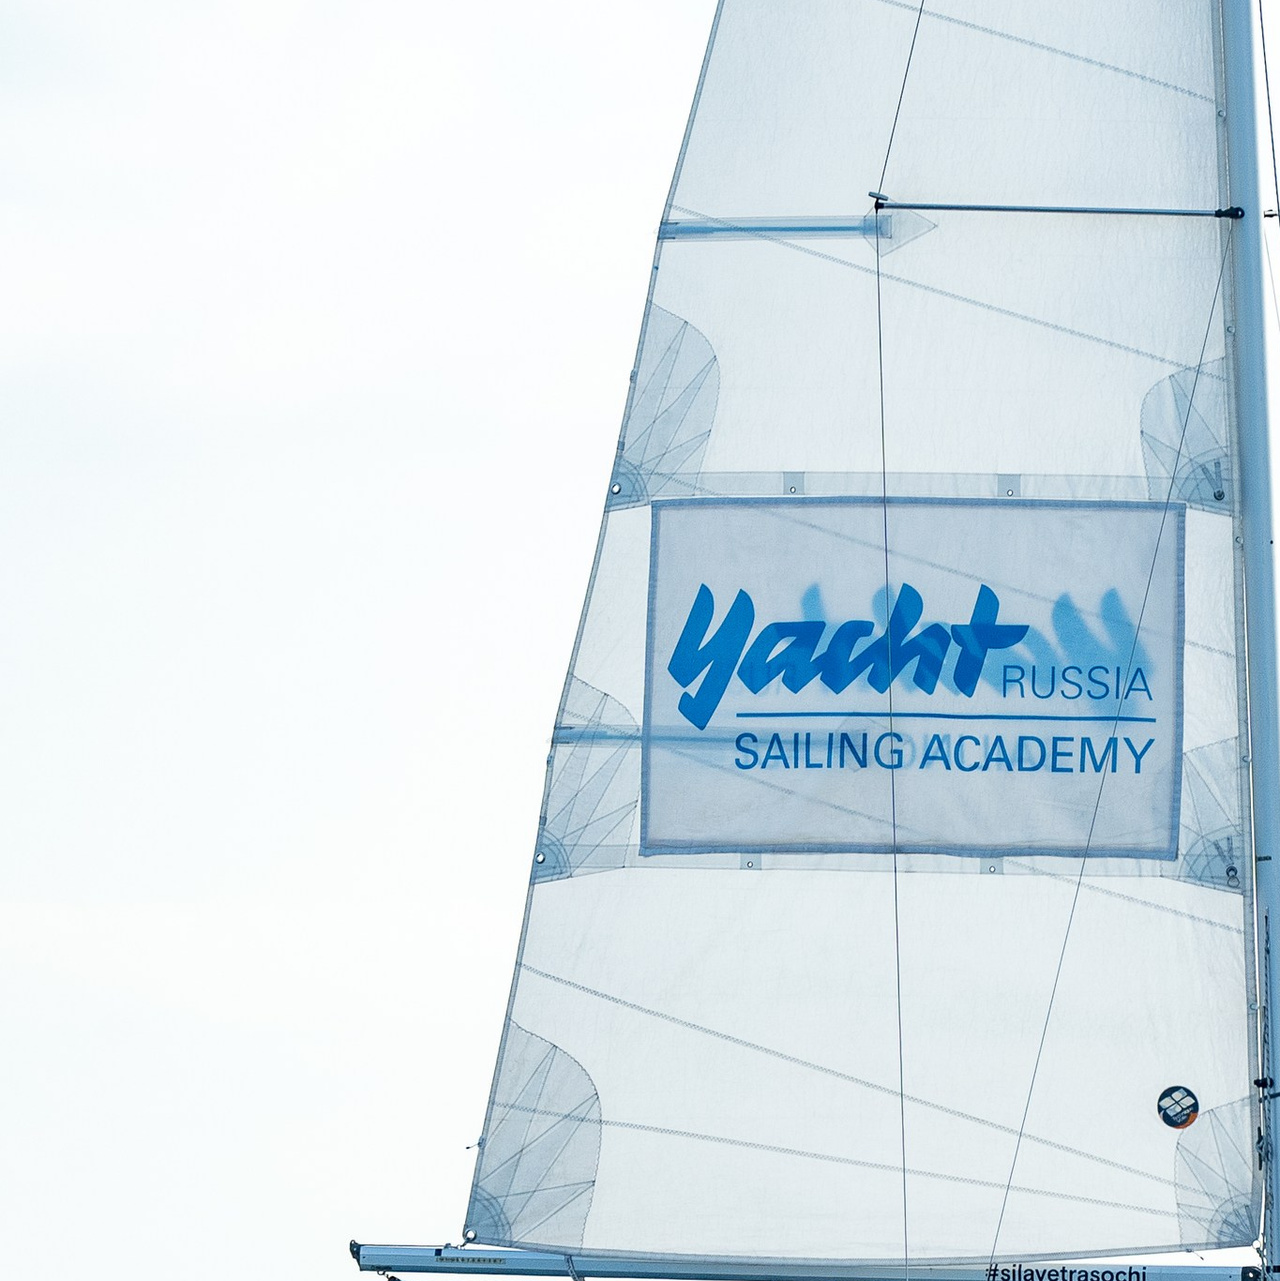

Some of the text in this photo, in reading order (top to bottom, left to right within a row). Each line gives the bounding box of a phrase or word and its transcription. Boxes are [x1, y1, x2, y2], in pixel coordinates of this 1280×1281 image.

[1002, 664, 1153, 702] RUSSIA
[734, 732, 1156, 774] SAILING ACADEMY
